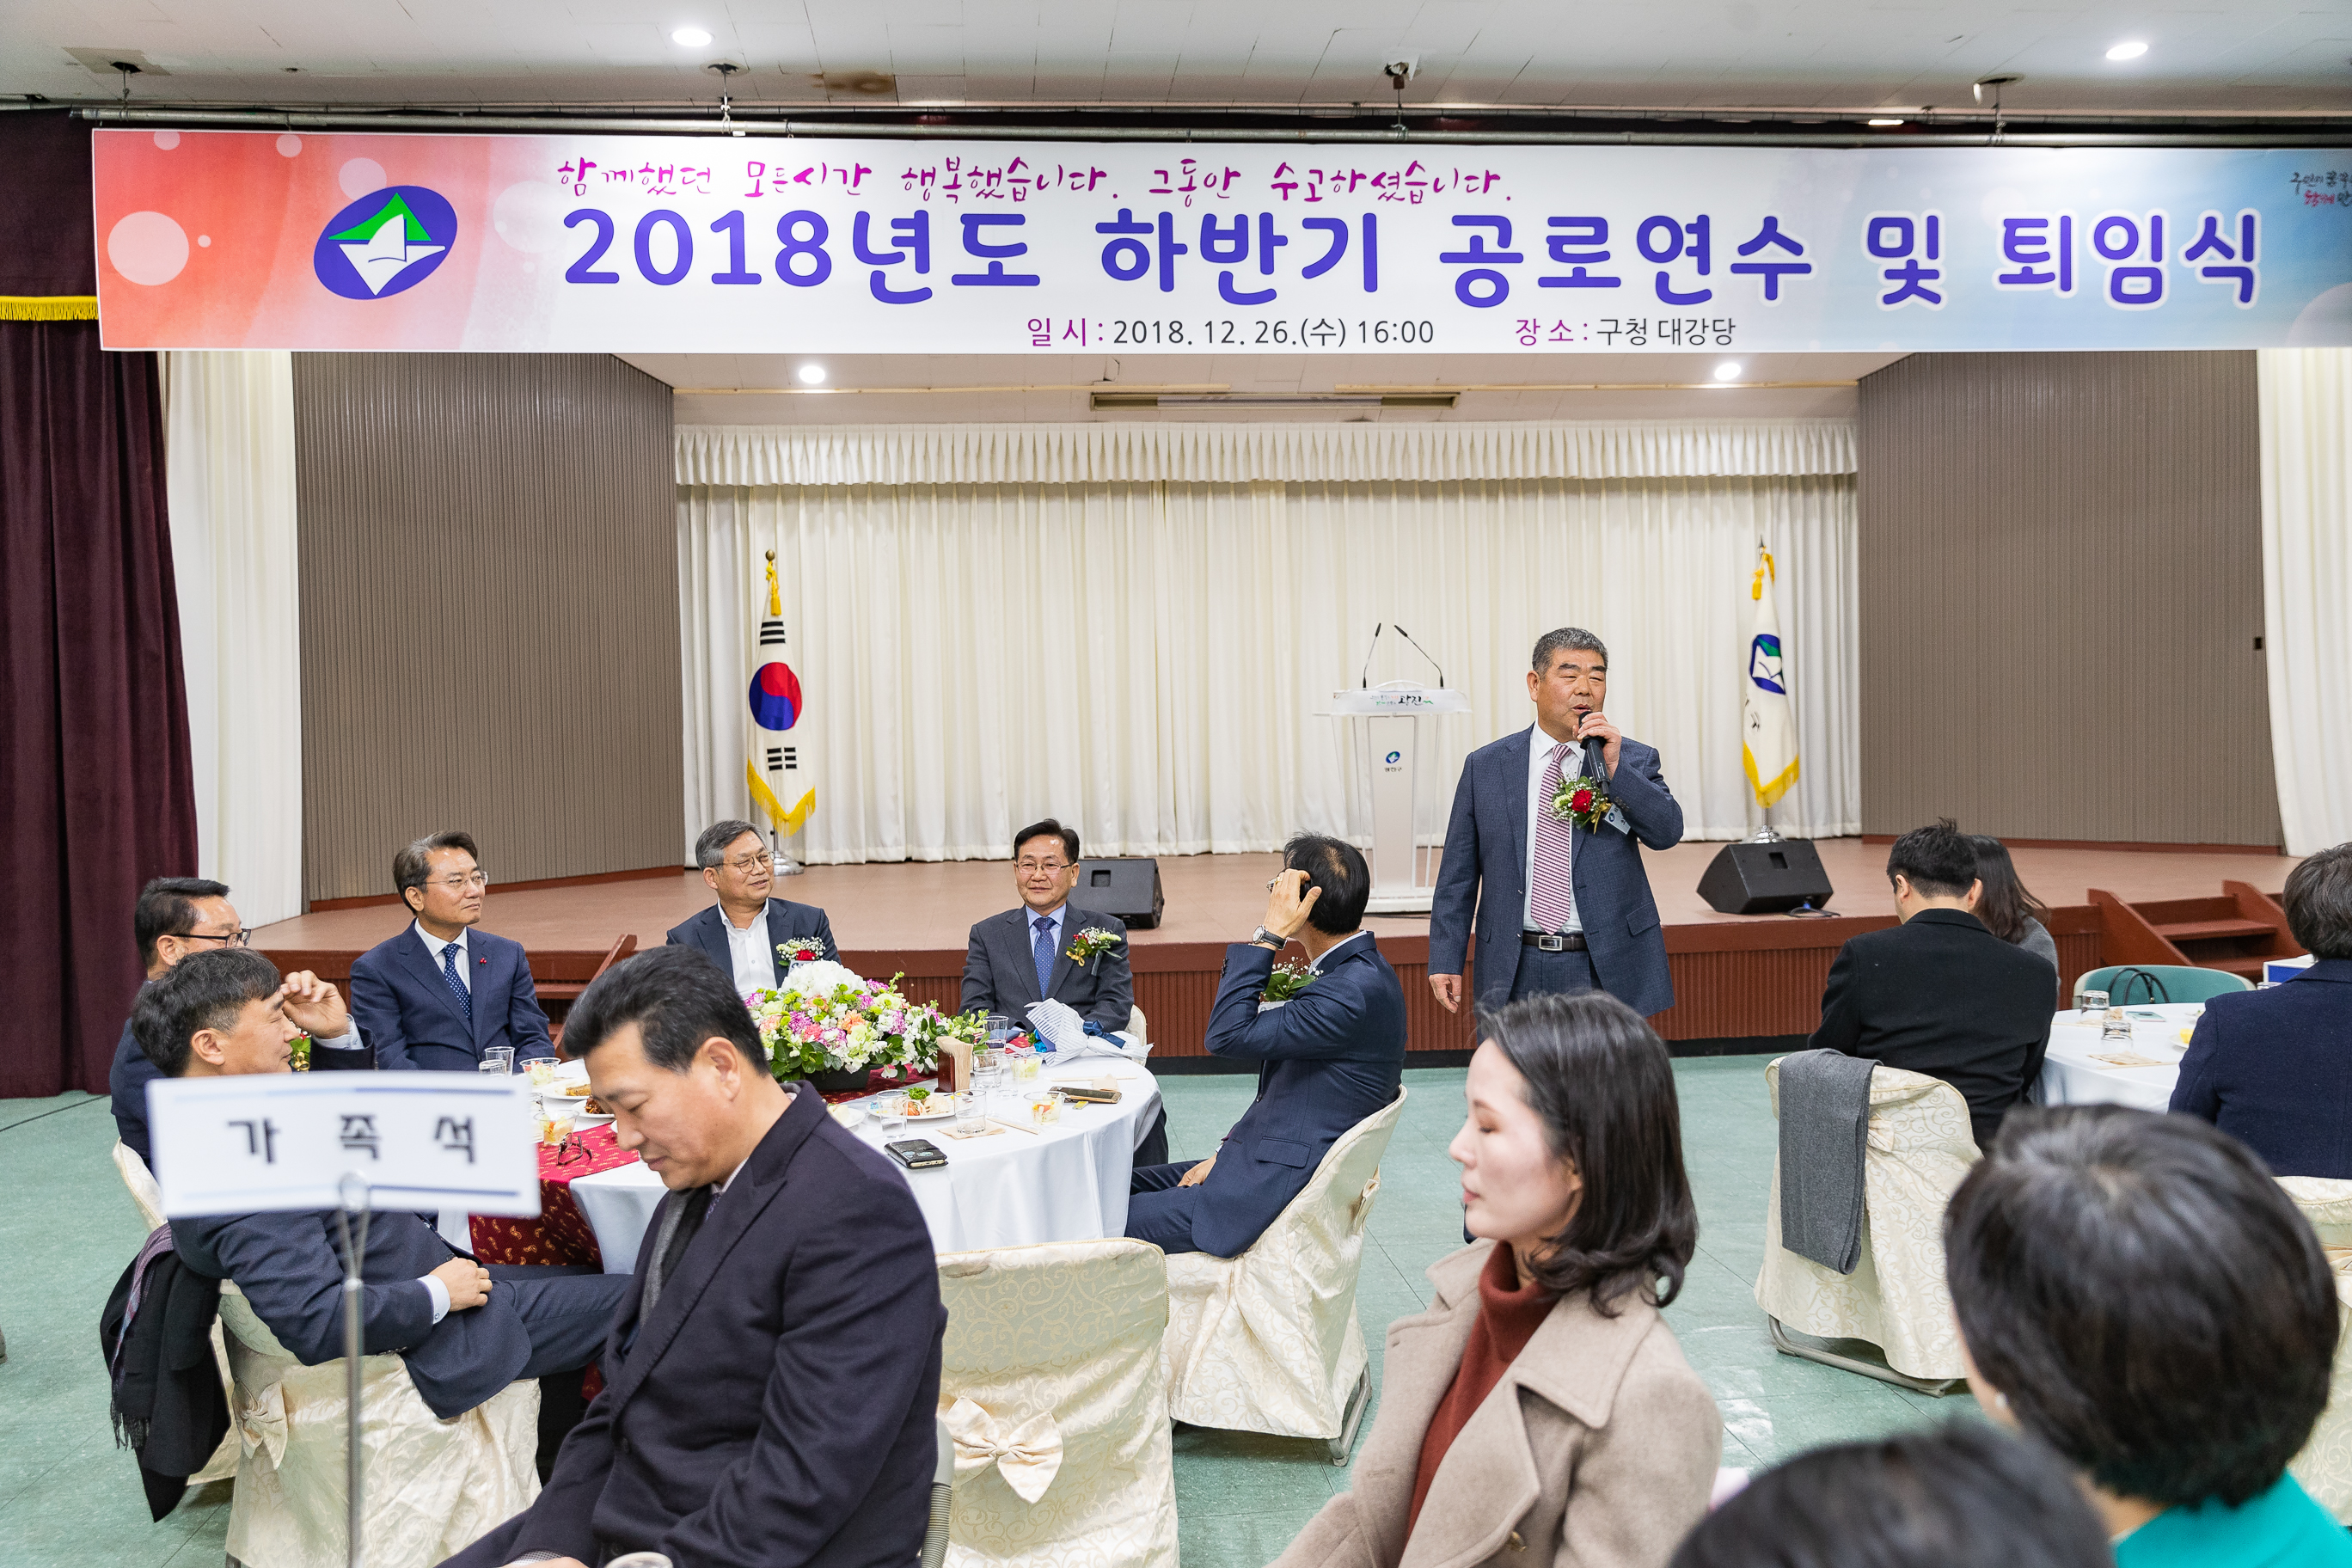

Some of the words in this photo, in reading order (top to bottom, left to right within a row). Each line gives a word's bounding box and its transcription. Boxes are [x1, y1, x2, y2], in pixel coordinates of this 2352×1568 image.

[557, 157, 711, 197] 함께했던
[744, 161, 873, 198] 모든시간
[901, 156, 1118, 204] 행복했습니다.
[1148, 158, 1241, 208] 그동안
[1271, 160, 1511, 205] 수고하셨습니다.
[563, 208, 1041, 305] 2018년도
[1094, 208, 1378, 305] 하반기
[1439, 213, 1813, 309] 공로연수
[1867, 214, 1946, 306] 및
[1994, 213, 2262, 306] 퇴임식
[1112, 320, 1193, 346] 2018.
[1204, 320, 1246, 346] 12.
[1254, 317, 1346, 348] 26.(수)
[1357, 320, 1435, 345] 16:00
[1596, 317, 1648, 346] 구청
[1657, 317, 1736, 346] 대강당
